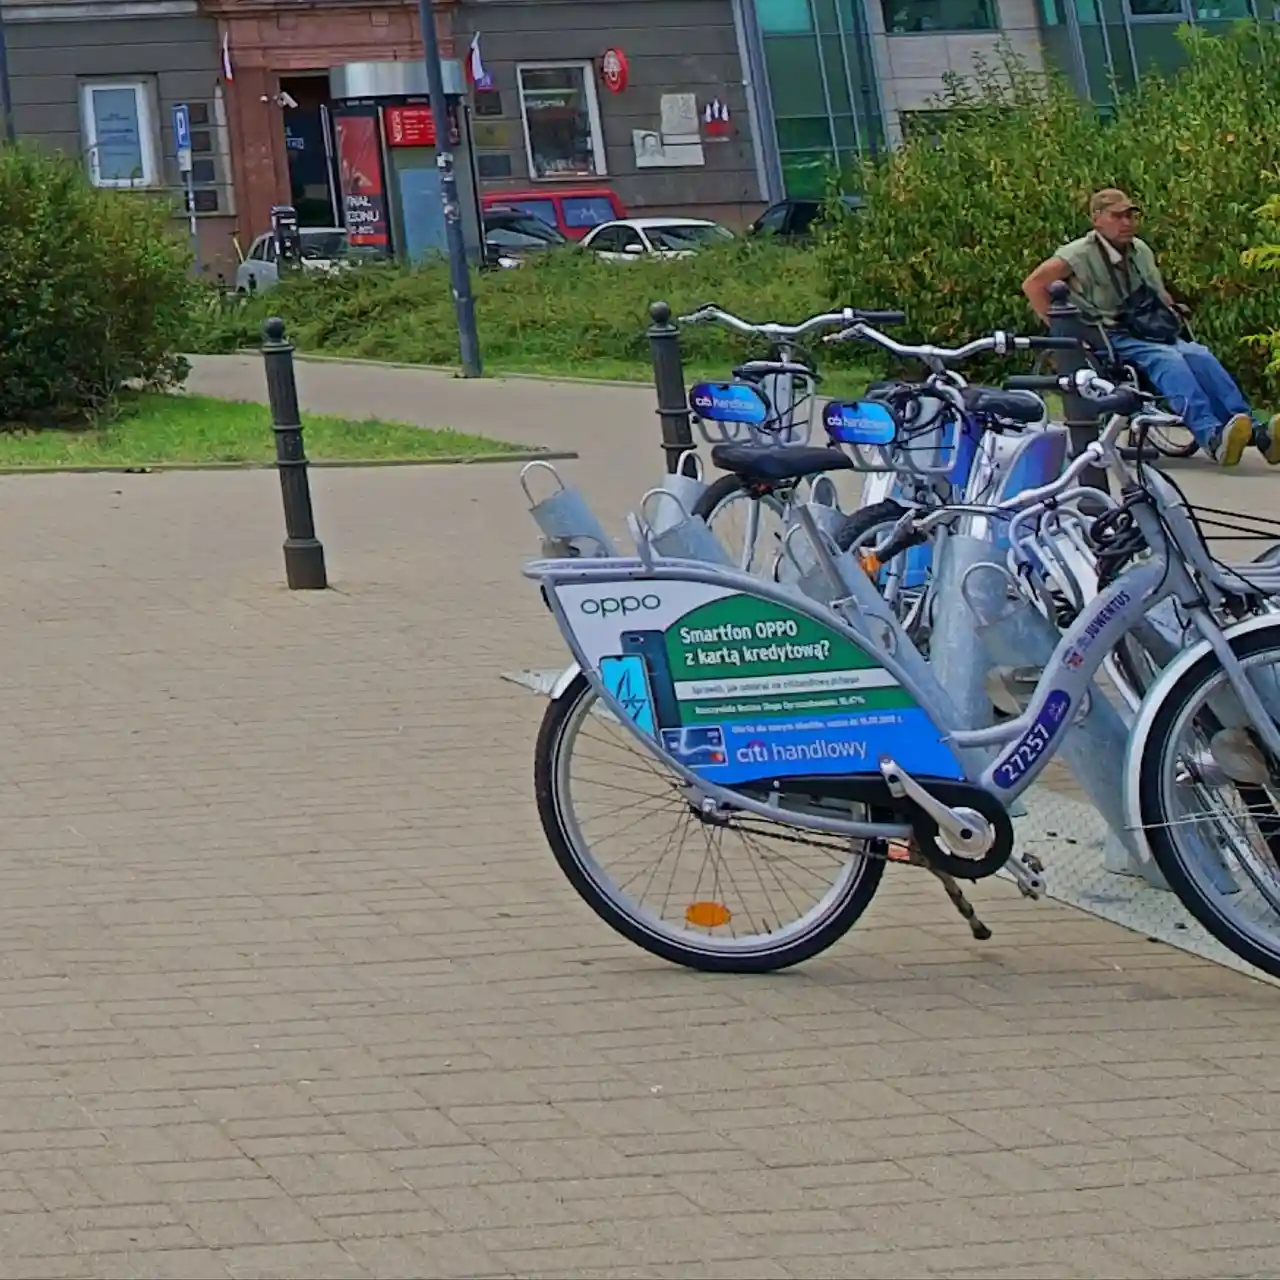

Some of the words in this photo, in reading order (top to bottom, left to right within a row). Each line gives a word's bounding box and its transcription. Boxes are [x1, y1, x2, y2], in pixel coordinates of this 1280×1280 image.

[580, 594, 661, 618] oppo
[679, 624, 752, 644] Smartfon
[755, 619, 798, 639] OPPO
[685, 653, 695, 666] z
[698, 647, 740, 667] kartą
[743, 639, 830, 663] kredytową?
[736, 741, 768, 764] citi
[772, 739, 867, 762] handlowy
[1001, 724, 1050, 781] 27257
